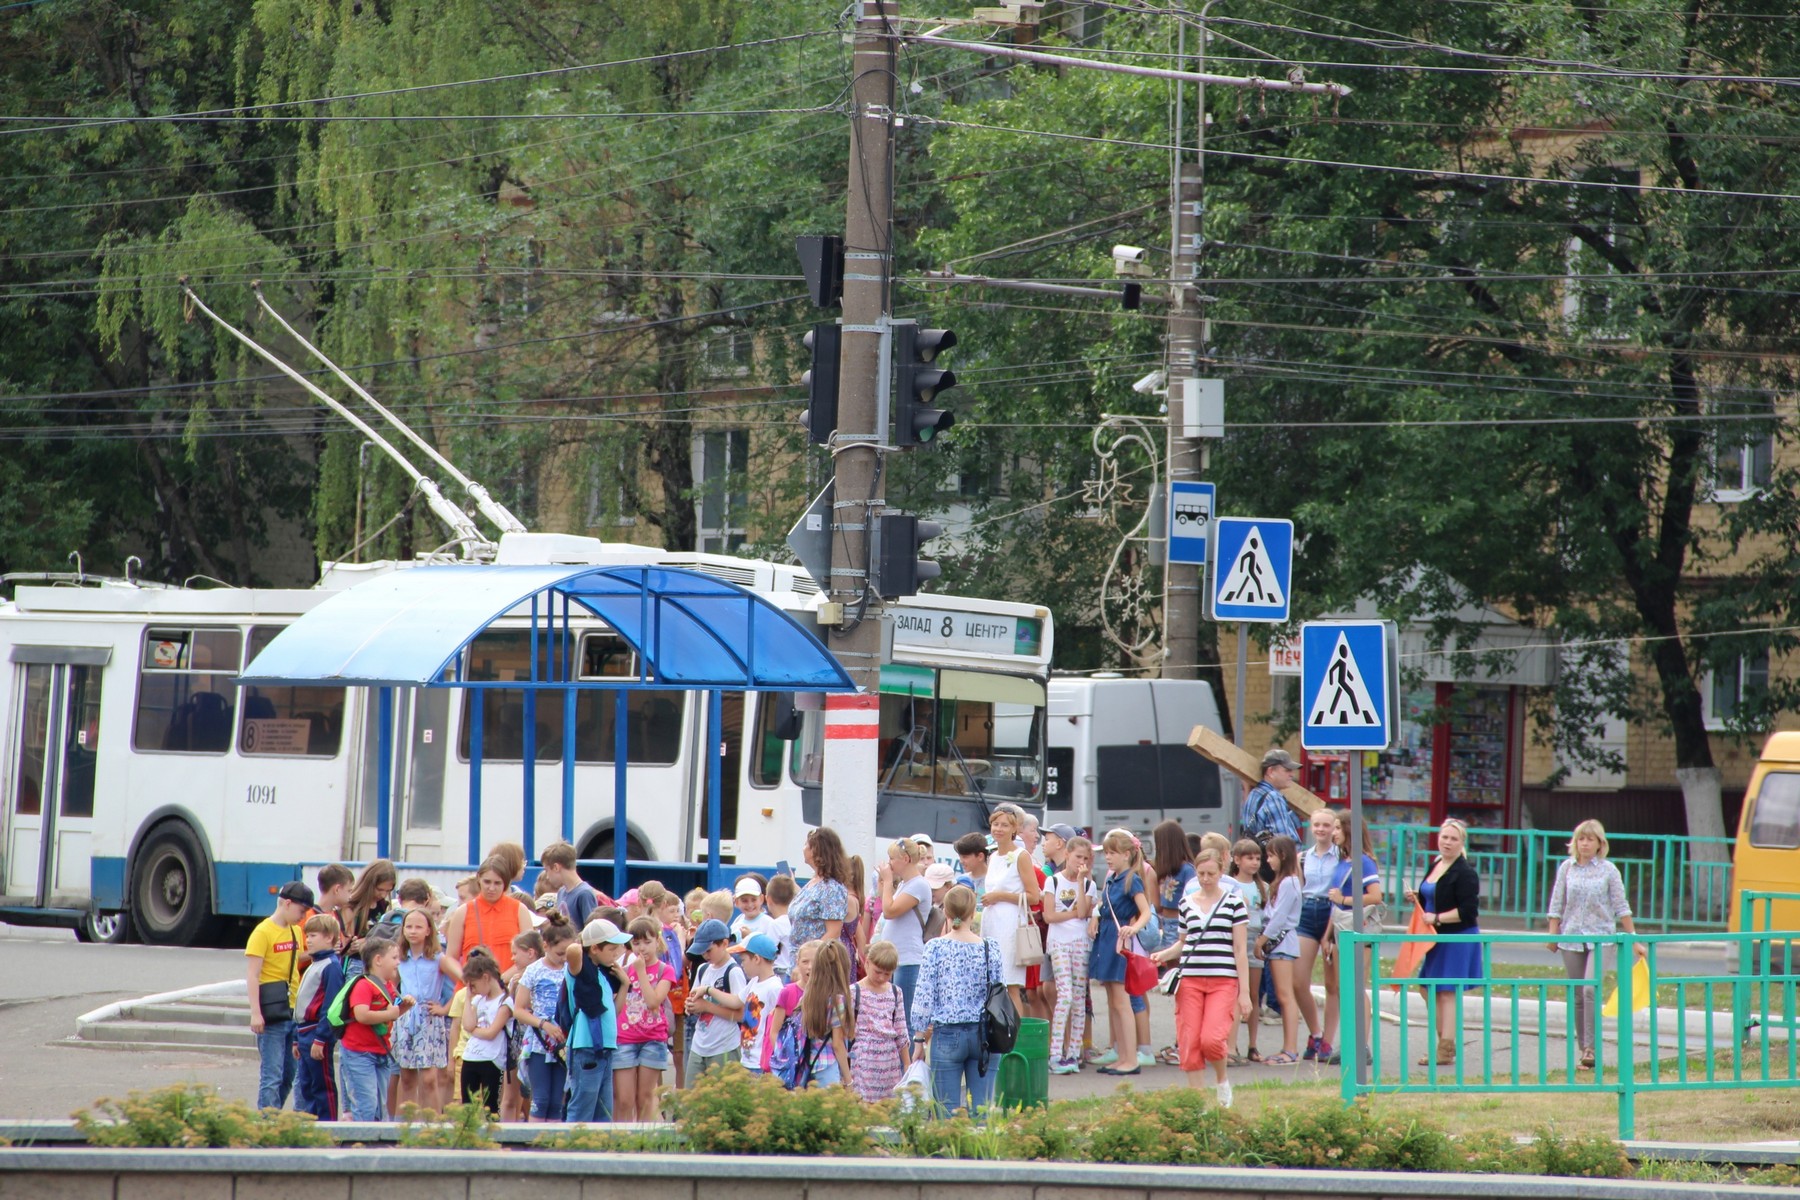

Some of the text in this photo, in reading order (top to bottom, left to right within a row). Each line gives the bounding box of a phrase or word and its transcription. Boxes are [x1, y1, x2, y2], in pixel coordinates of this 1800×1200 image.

[941, 616, 953, 638] 8
[966, 622, 1008, 639] ЦЕНТР
[246, 726, 255, 749] 8
[246, 784, 277, 804] 1091
